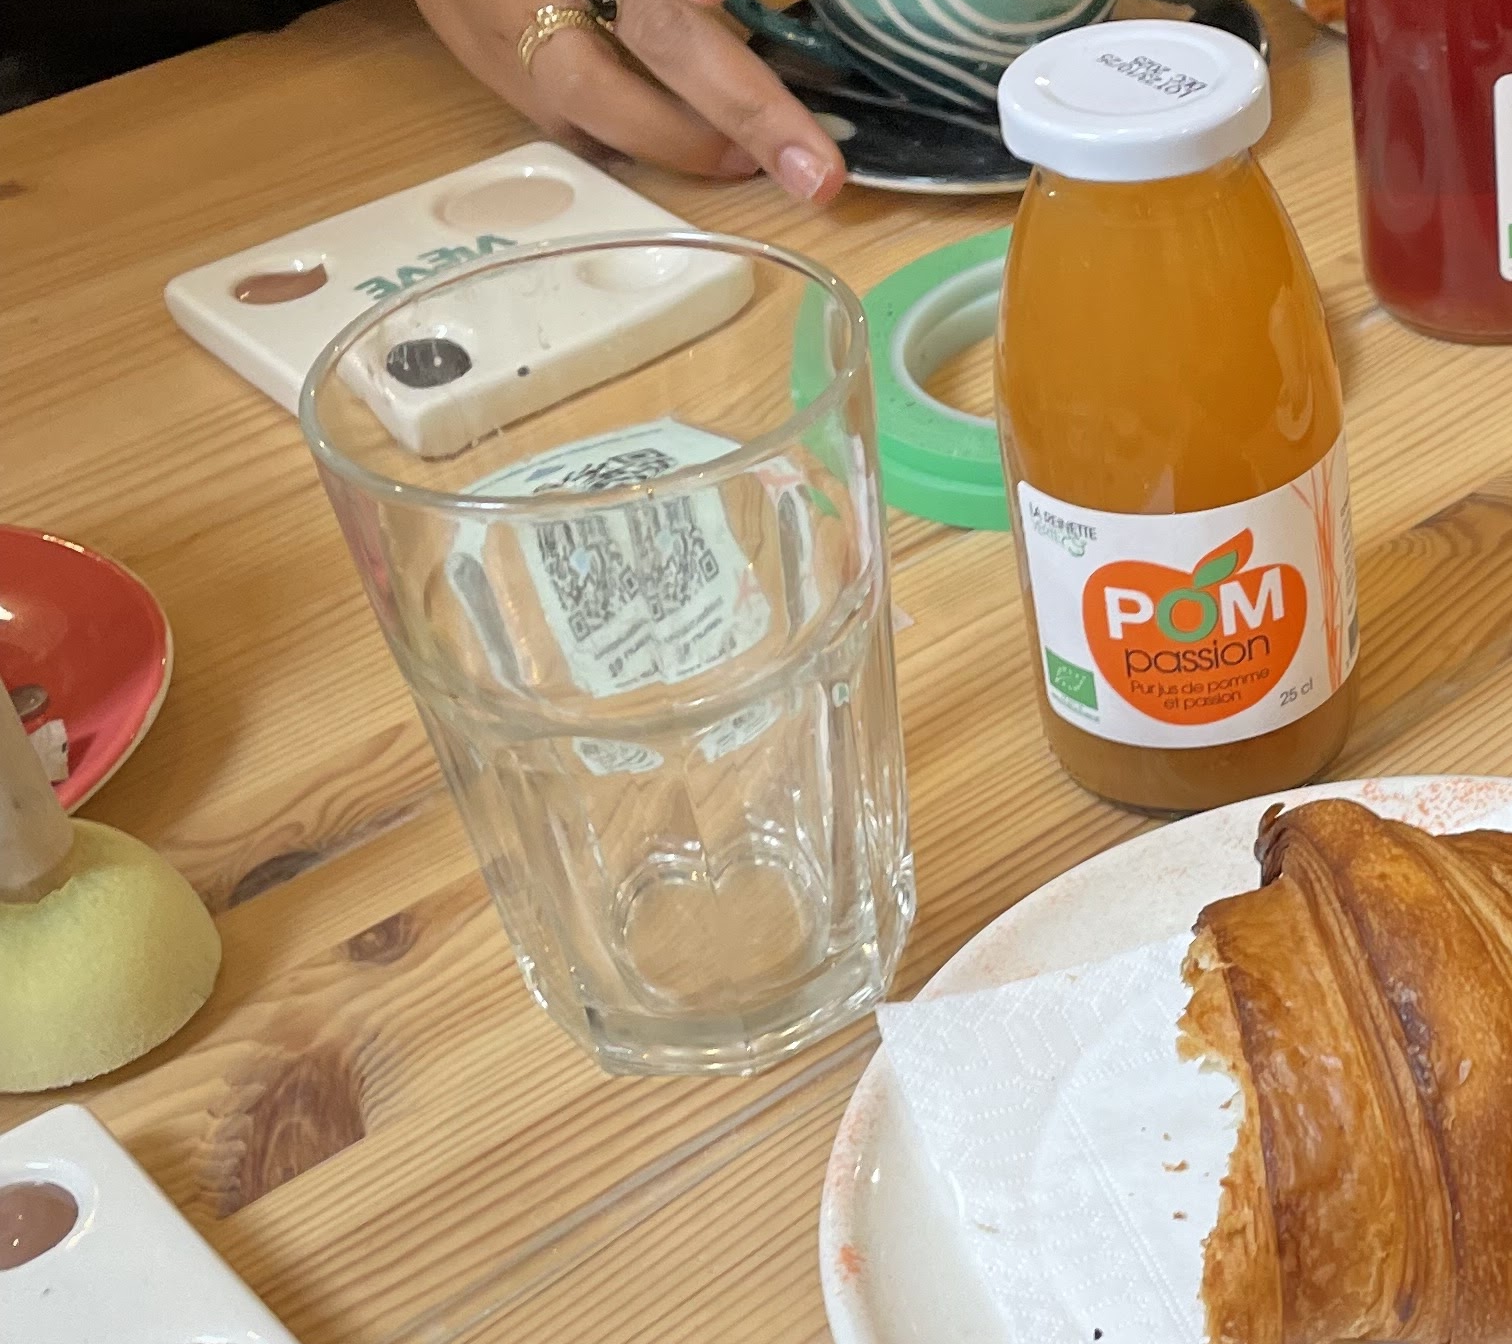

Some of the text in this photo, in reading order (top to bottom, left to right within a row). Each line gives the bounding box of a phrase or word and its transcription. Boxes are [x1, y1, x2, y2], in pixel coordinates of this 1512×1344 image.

[1103, 565, 1285, 643] POM
[1124, 634, 1271, 678] passion
[1130, 667, 1271, 698] Pur jus de pomme
[1278, 676, 1314, 708] 25 cl
[1163, 690, 1242, 711] et passion
